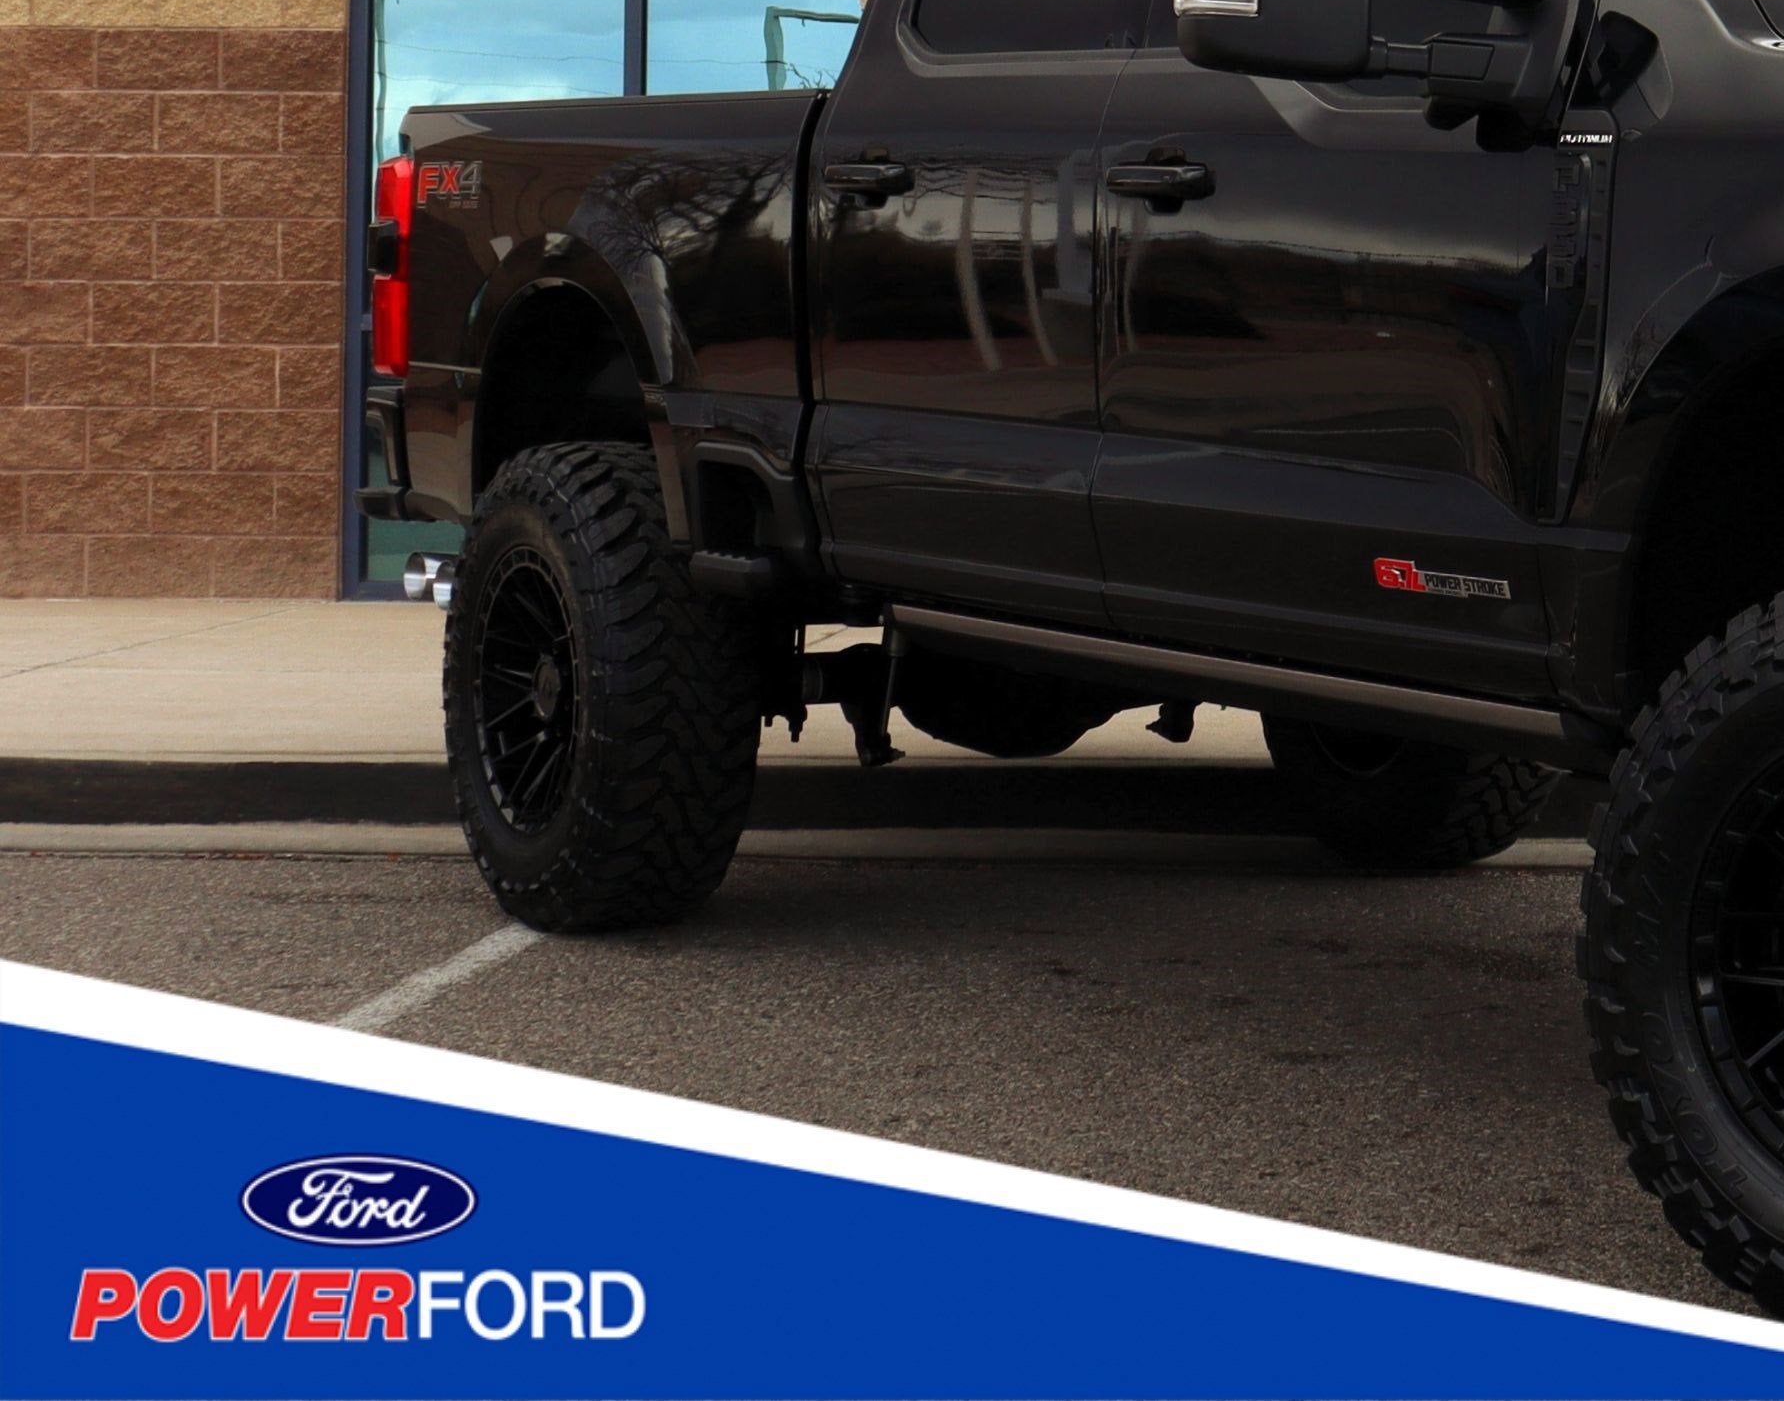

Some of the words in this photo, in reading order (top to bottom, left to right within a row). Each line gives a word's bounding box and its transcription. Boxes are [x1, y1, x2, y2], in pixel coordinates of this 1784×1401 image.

[416, 160, 483, 207] FX4
[1424, 572, 1462, 591] POWER
[1462, 578, 1506, 597] STROKE
[1642, 1010, 1748, 1202] TOYO
